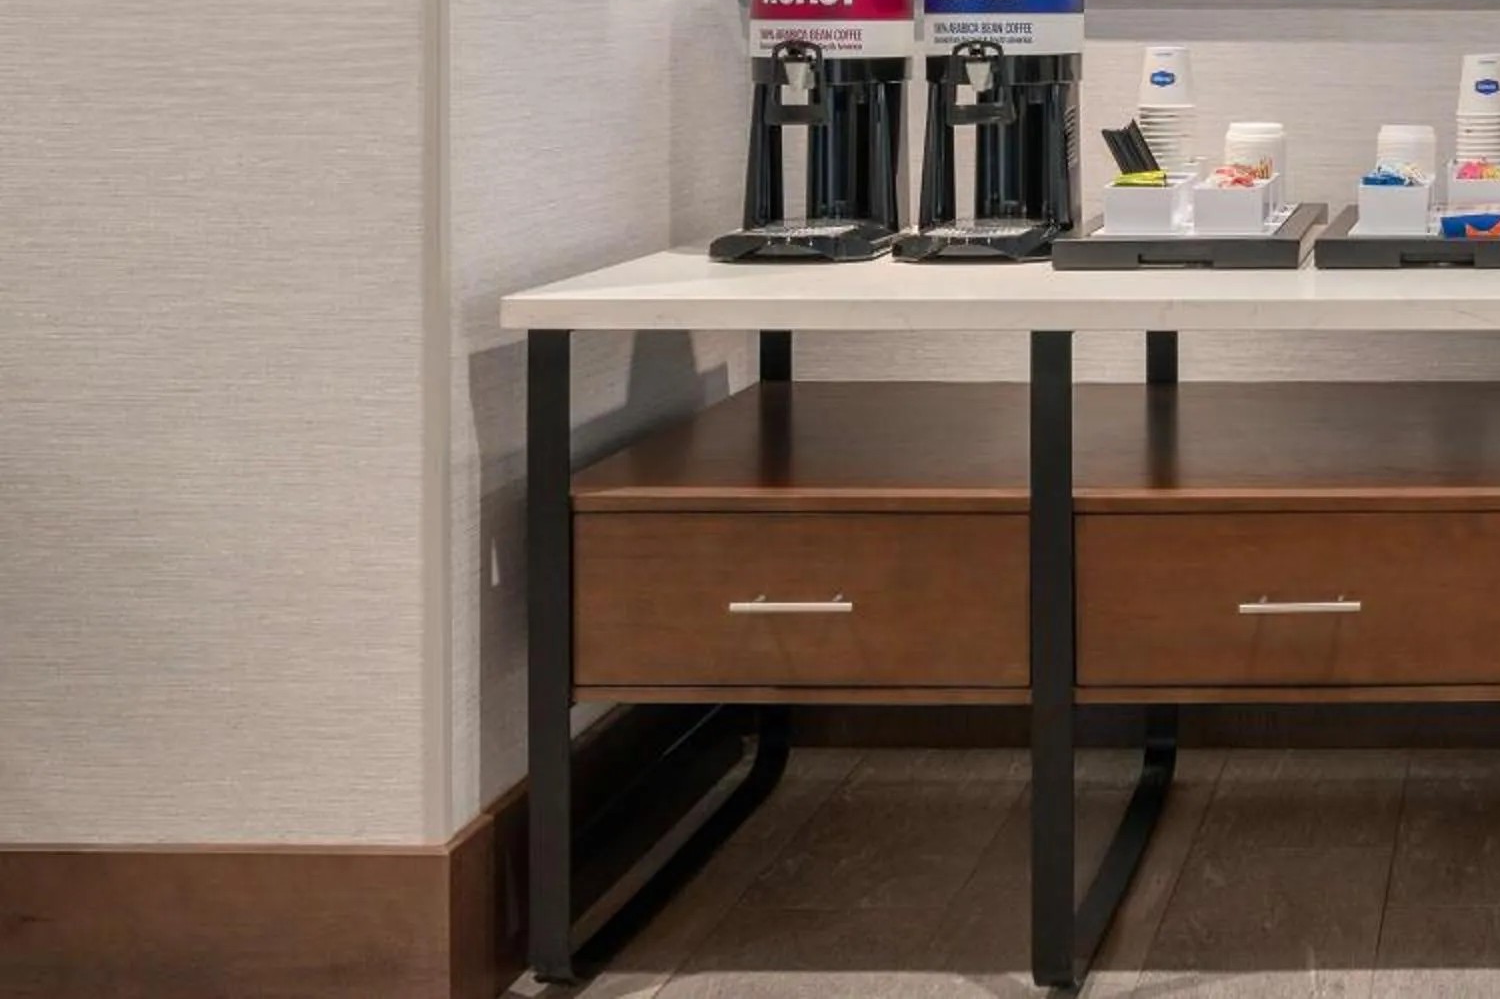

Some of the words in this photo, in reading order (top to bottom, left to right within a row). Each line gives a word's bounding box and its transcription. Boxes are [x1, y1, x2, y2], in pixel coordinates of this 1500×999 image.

[810, 28, 833, 40] BEAN
[834, 28, 863, 40] COFFEE
[981, 22, 1003, 34] BEAN
[1005, 22, 1033, 34] COFFEE
